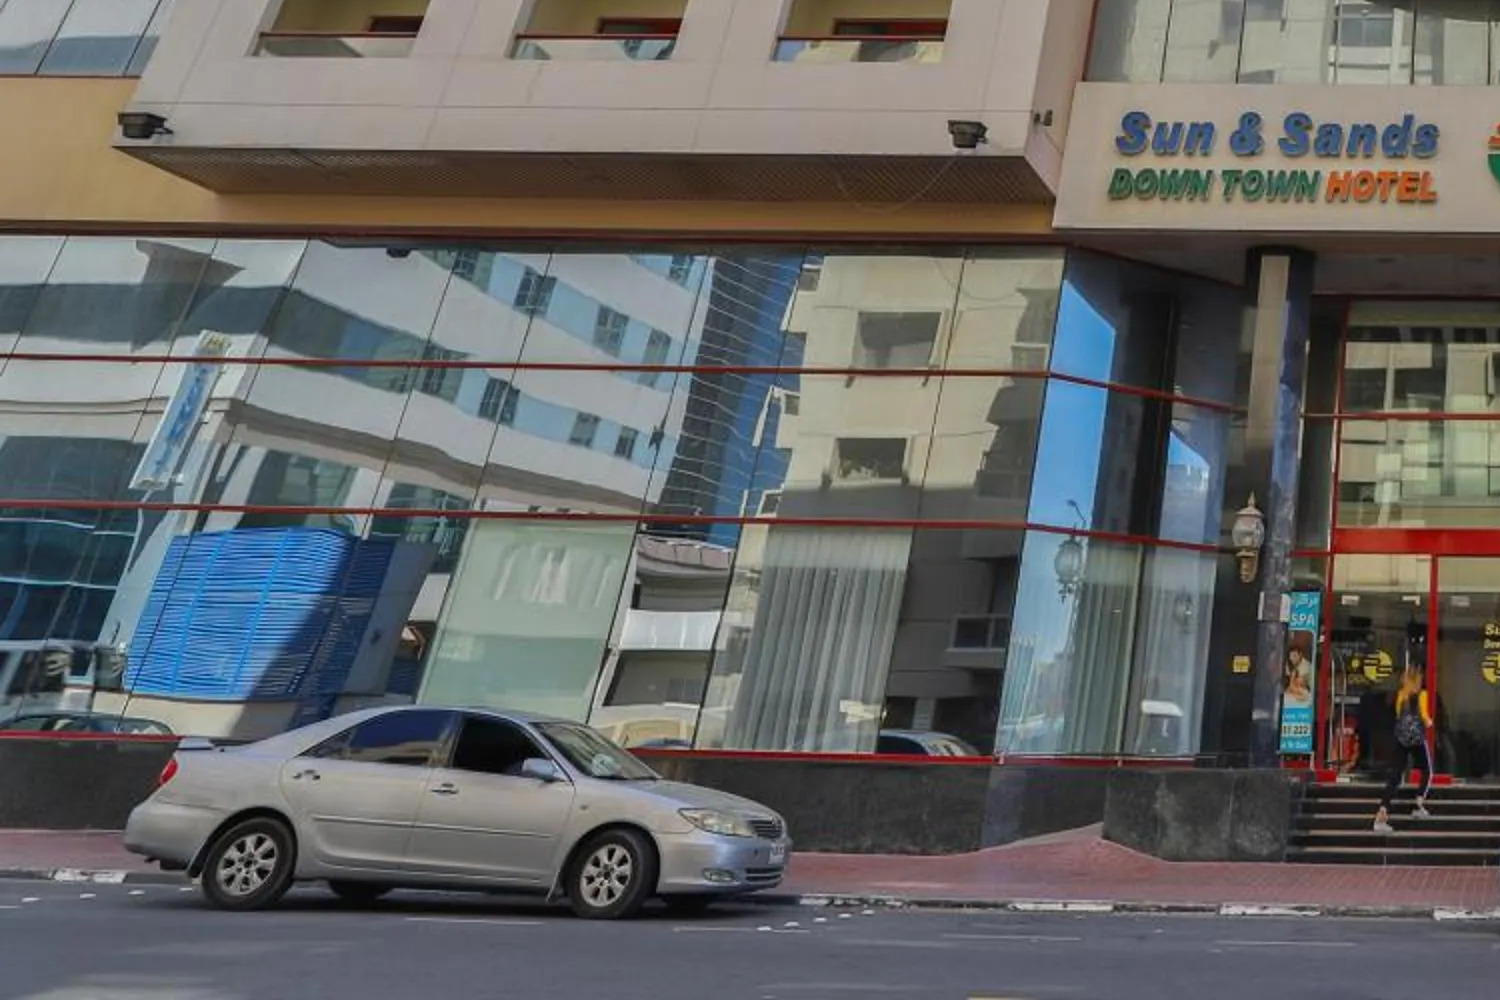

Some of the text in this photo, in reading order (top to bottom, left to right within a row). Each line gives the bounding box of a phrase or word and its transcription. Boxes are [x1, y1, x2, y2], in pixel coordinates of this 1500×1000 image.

[1115, 111, 1441, 159] Sun & Sands
[1107, 167, 1438, 204] DOWN TOWN HOTEL
